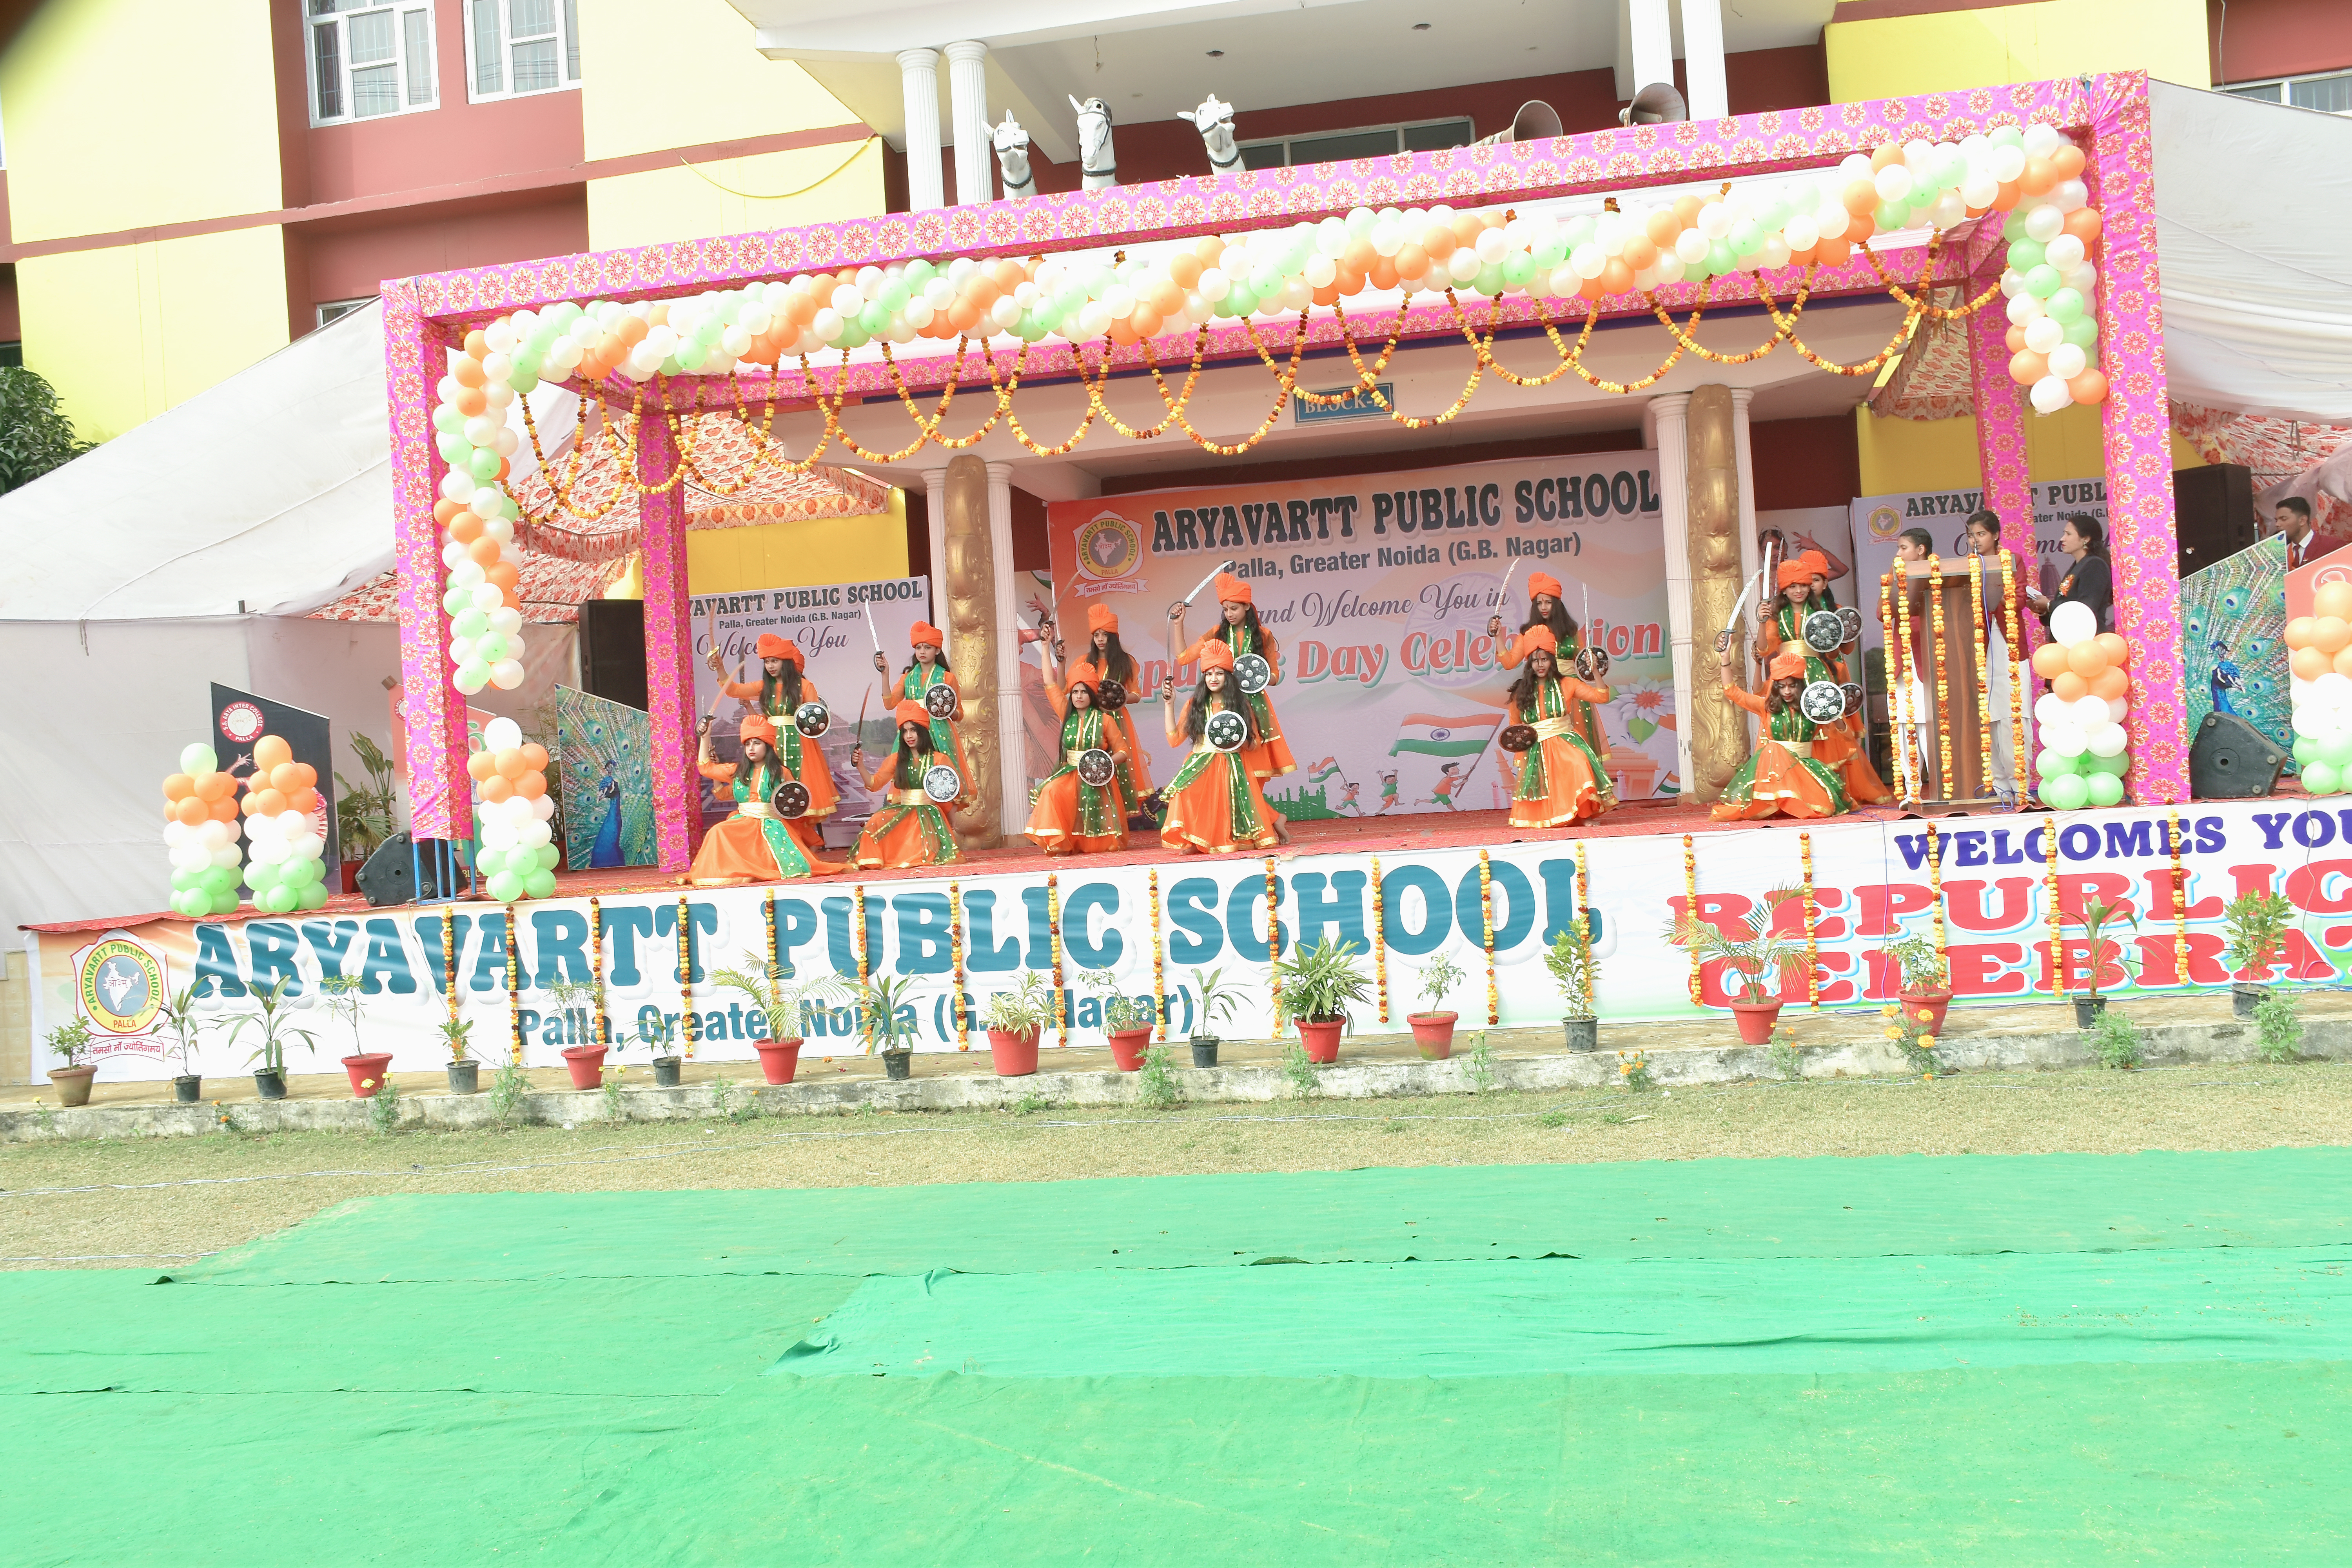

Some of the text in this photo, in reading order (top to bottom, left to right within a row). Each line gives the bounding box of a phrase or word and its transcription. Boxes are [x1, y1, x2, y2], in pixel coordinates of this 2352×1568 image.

[1305, 393, 1381, 414] BLOCK-
[1152, 470, 1659, 552] ARYAVARTT PUBLIC SCHOOL
[2048, 482, 2107, 505] PUBL
[1081, 521, 1136, 561] ARYAVARTT PUBLIC SCHOOL
[1223, 532, 1581, 580] Palla, Greater Noida (G.B. Nagar)
[773, 588, 840, 610] PUBLIC
[848, 581, 922, 604] SCHOOL
[1301, 589, 1414, 628] Welcome
[1419, 583, 1480, 620] You
[1486, 588, 1511, 607] in
[719, 610, 861, 629] Palla, Greater Noida (G.B. Nagar)
[797, 626, 849, 658] You
[1296, 640, 1385, 684] Day
[223, 708, 234, 720] ARYA
[250, 706, 263, 727] COLLEGE
[1894, 817, 2227, 870] WELCOMES
[191, 858, 1602, 999] ARYAVARTT PUBLIC SCHOOL
[85, 944, 160, 1004] ARYAVARTT PUBLIC SCHOOL
[113, 1020, 136, 1028] PALLA
[93, 1043, 112, 1054] तमसो
